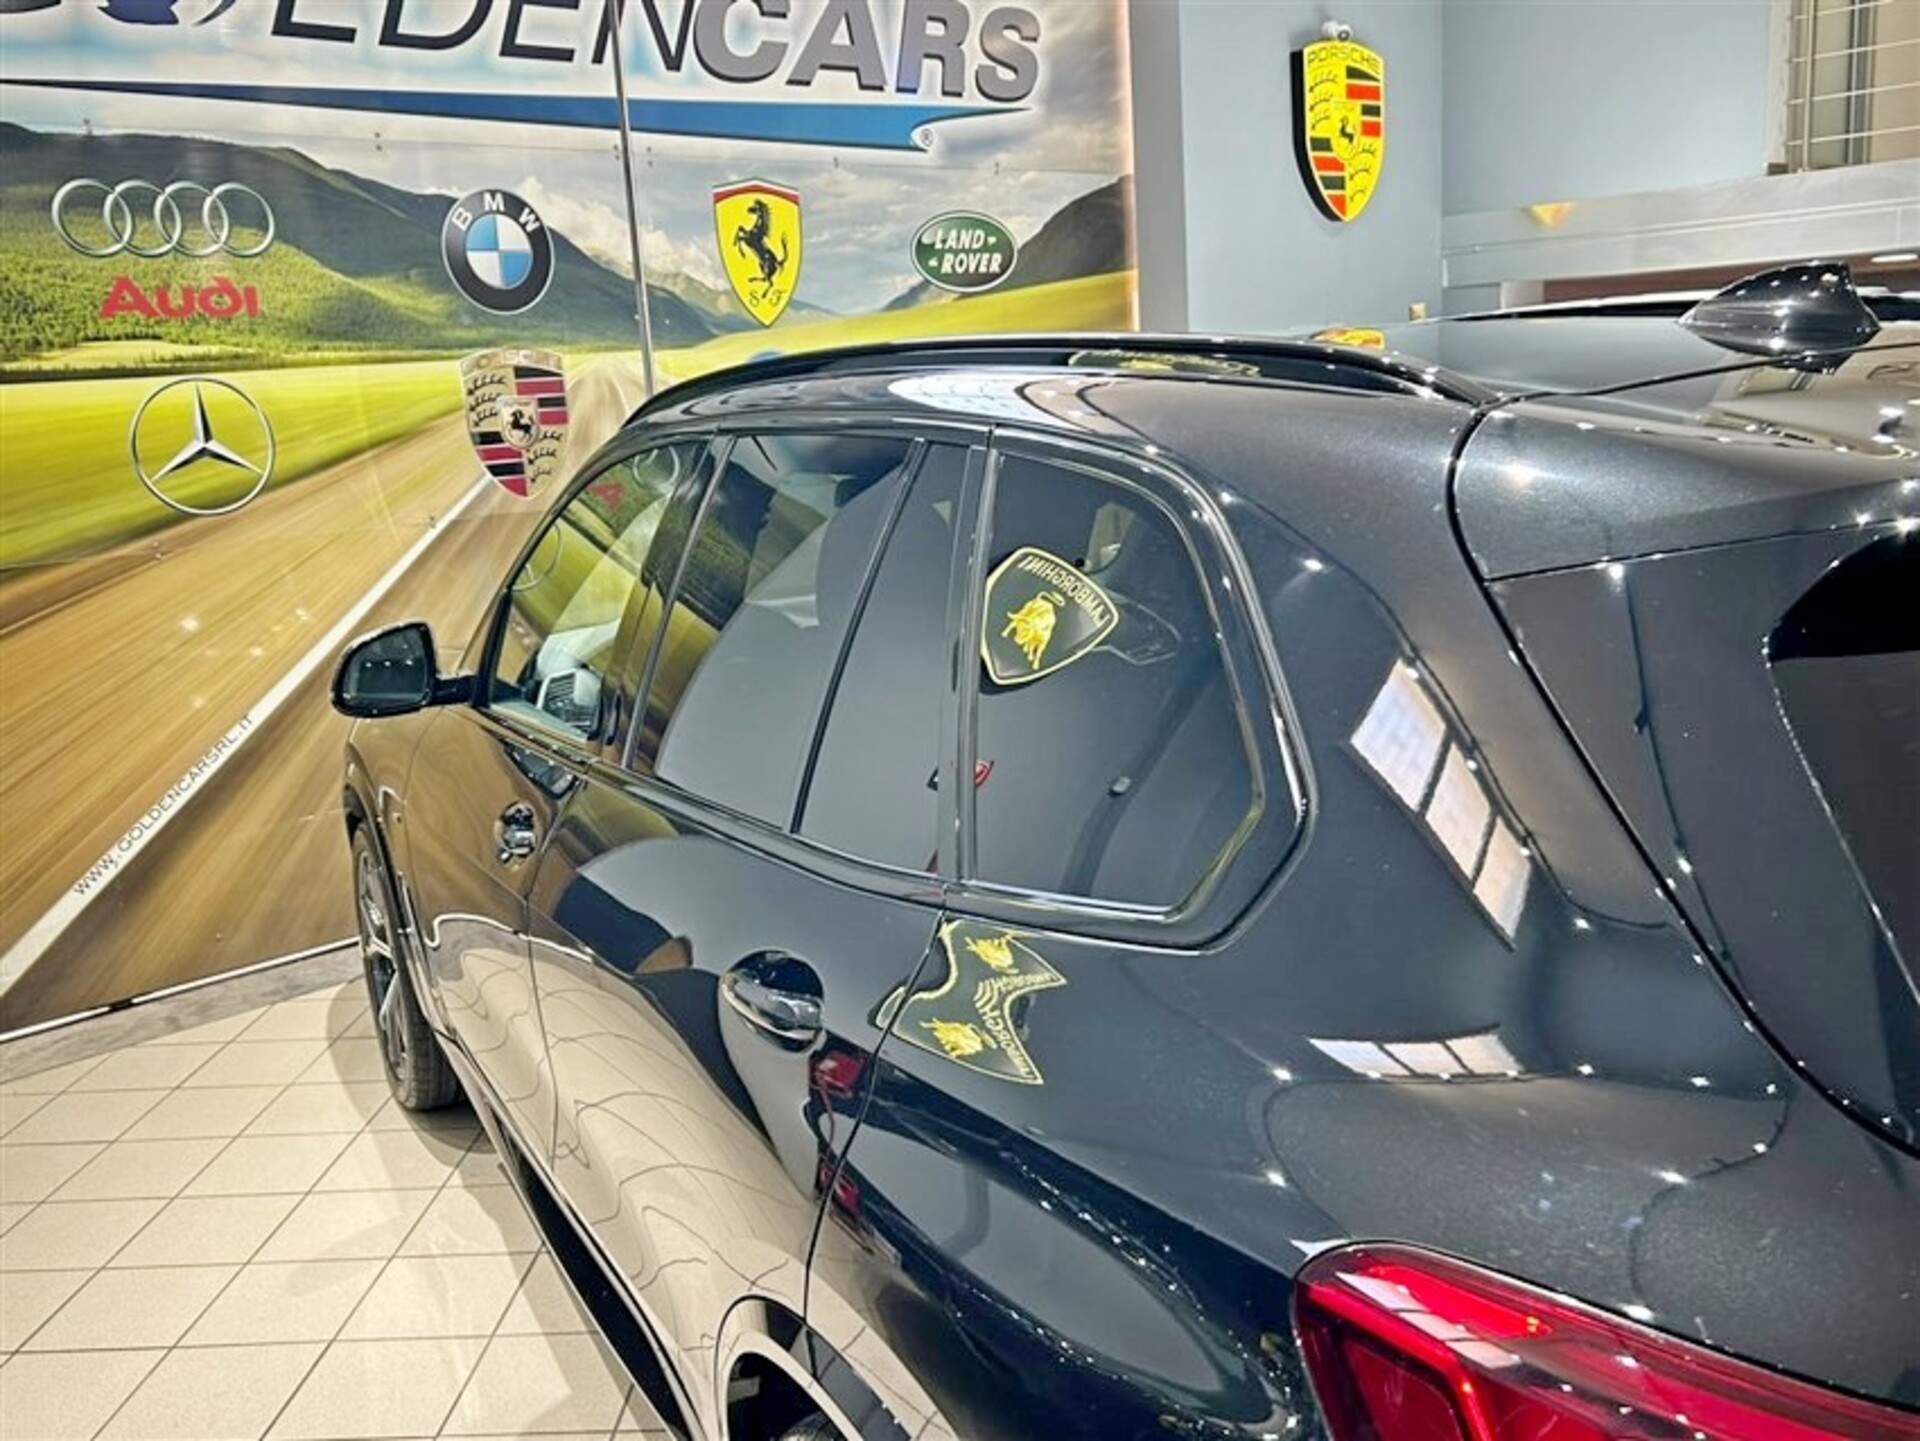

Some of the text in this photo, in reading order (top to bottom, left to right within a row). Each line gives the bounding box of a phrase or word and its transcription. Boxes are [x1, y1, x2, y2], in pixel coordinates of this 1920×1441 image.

[1307, 45, 1381, 76] PORSCHE
[451, 191, 541, 233] BMW
[934, 229, 985, 249] LAND
[941, 252, 1001, 274] ROVER
[101, 275, 259, 318] Audi
[73, 713, 253, 896] WWW.GOLDENCARSRL.IT
